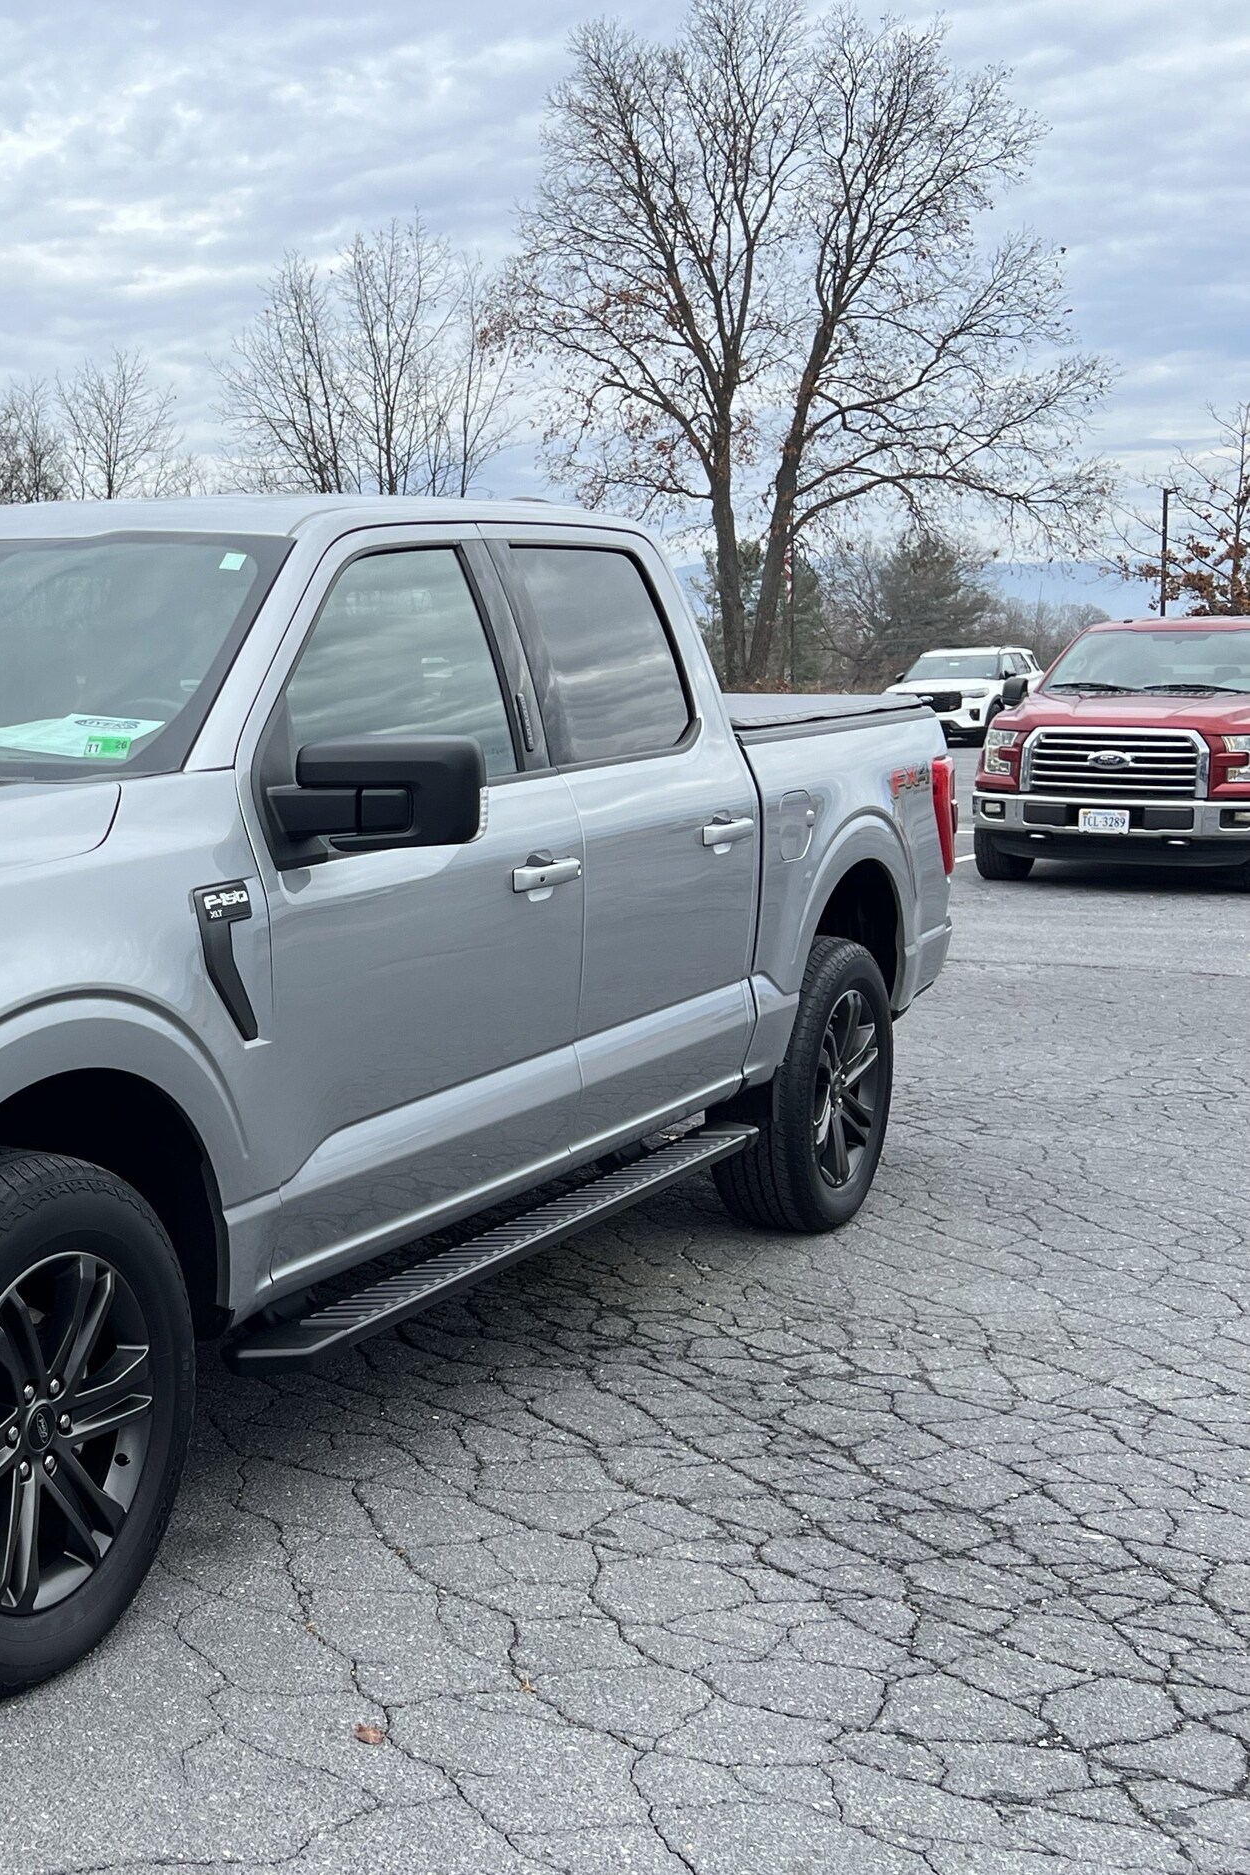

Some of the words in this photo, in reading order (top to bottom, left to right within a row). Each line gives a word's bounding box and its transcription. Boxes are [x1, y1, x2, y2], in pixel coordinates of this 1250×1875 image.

[87, 743, 100, 753] 11
[892, 760, 930, 799] FX4
[203, 890, 249, 909] F-150
[210, 909, 223, 919] XLT
